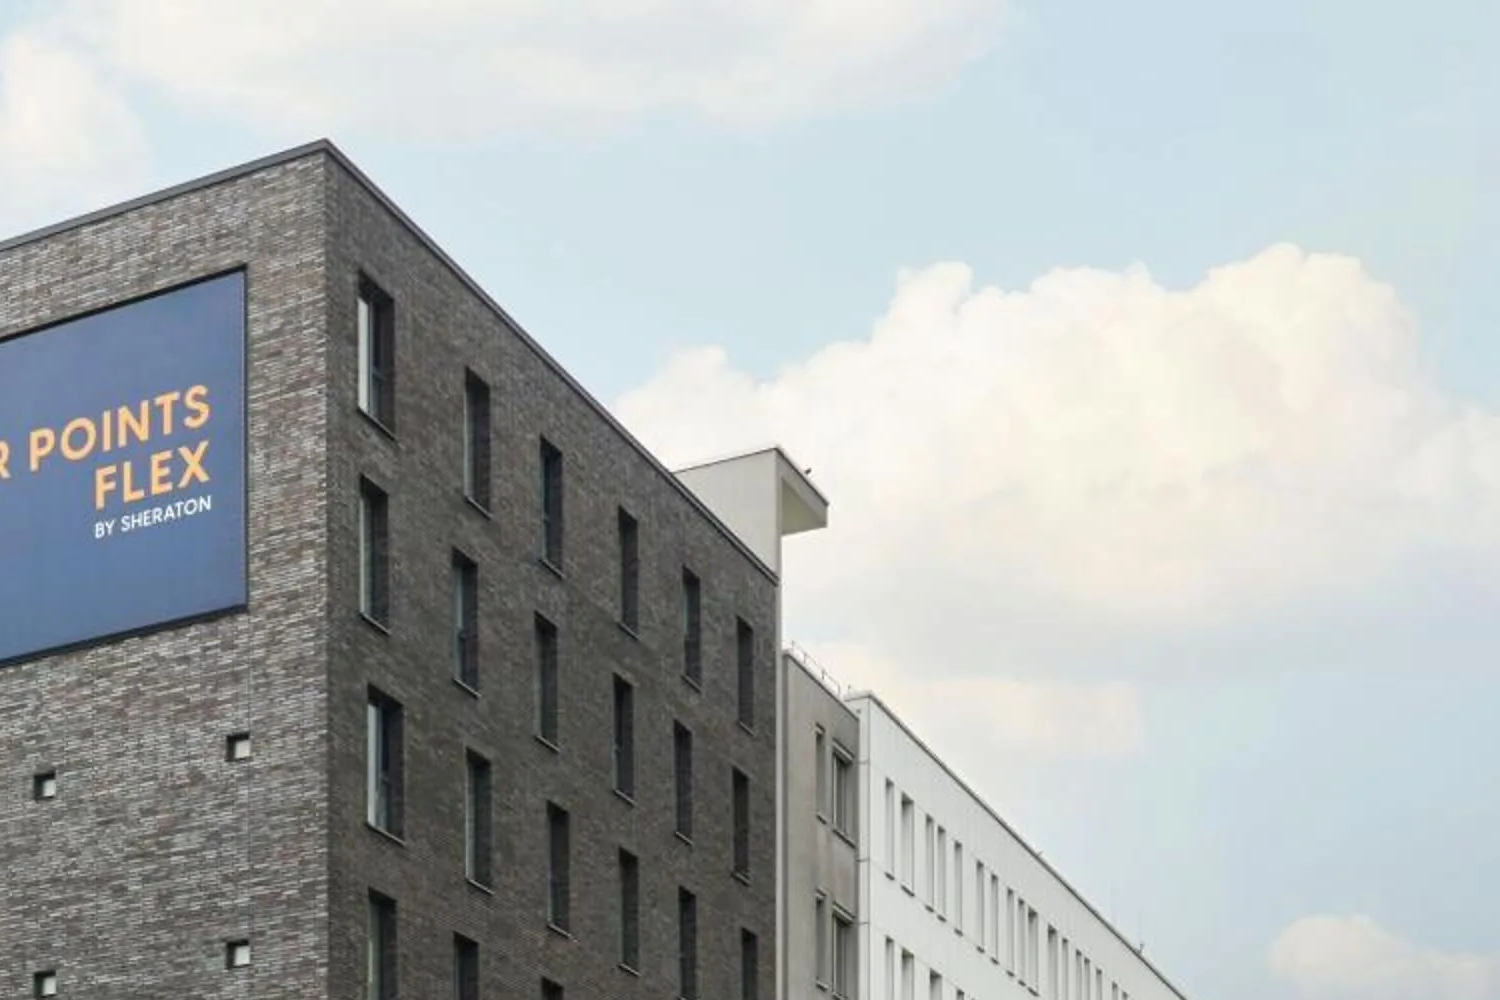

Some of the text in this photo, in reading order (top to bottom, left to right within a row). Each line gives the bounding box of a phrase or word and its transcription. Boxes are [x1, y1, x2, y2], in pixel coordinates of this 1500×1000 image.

[28, 384, 212, 472] POINTS
[94, 441, 211, 510] FLEX
[94, 495, 212, 539] BY SHERATON
